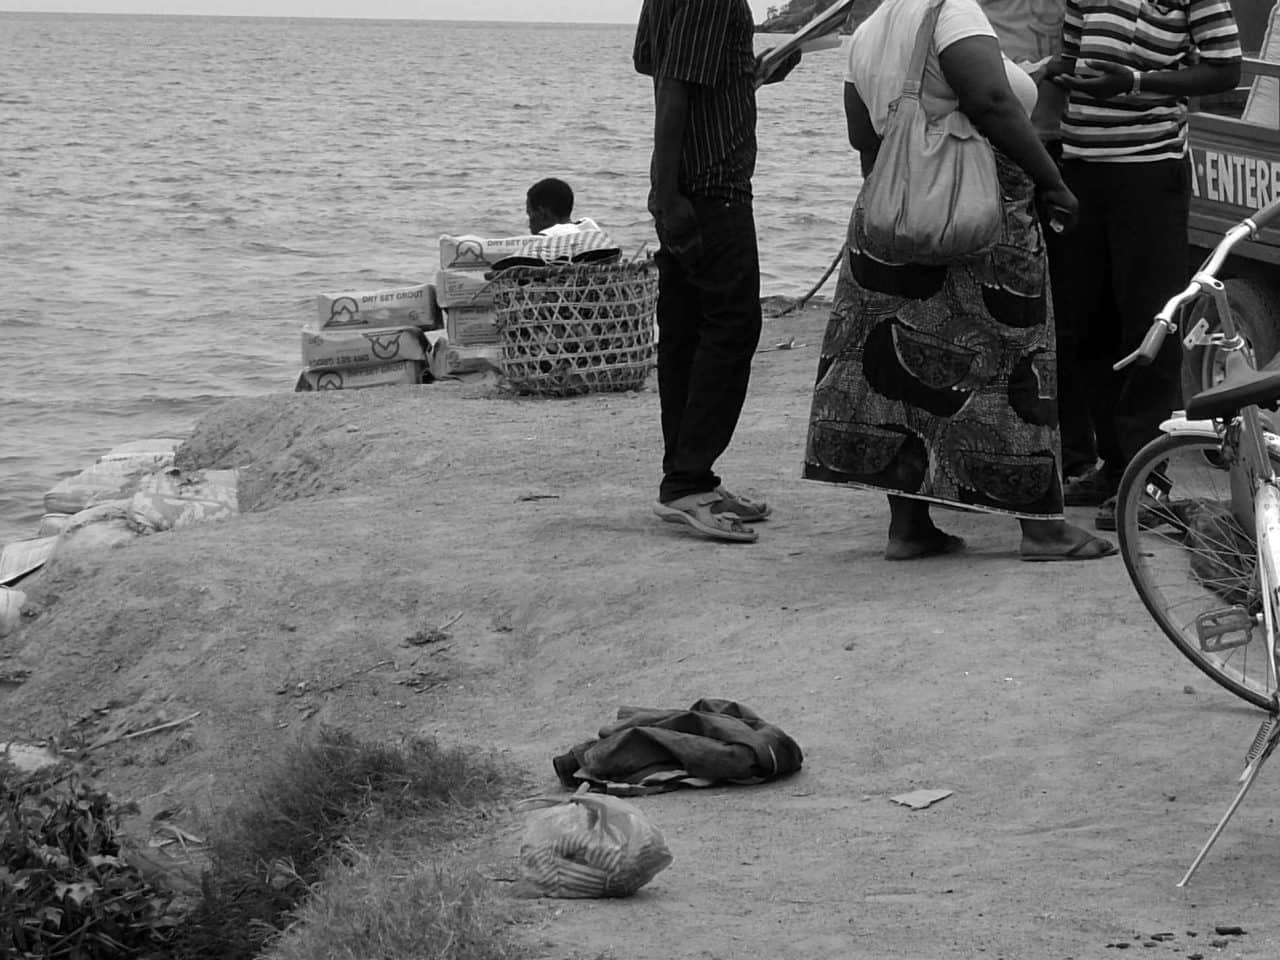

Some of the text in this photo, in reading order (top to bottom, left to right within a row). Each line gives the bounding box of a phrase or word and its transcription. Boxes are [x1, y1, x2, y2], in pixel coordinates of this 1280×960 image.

[361, 289, 424, 303] DRY SET GROUT
